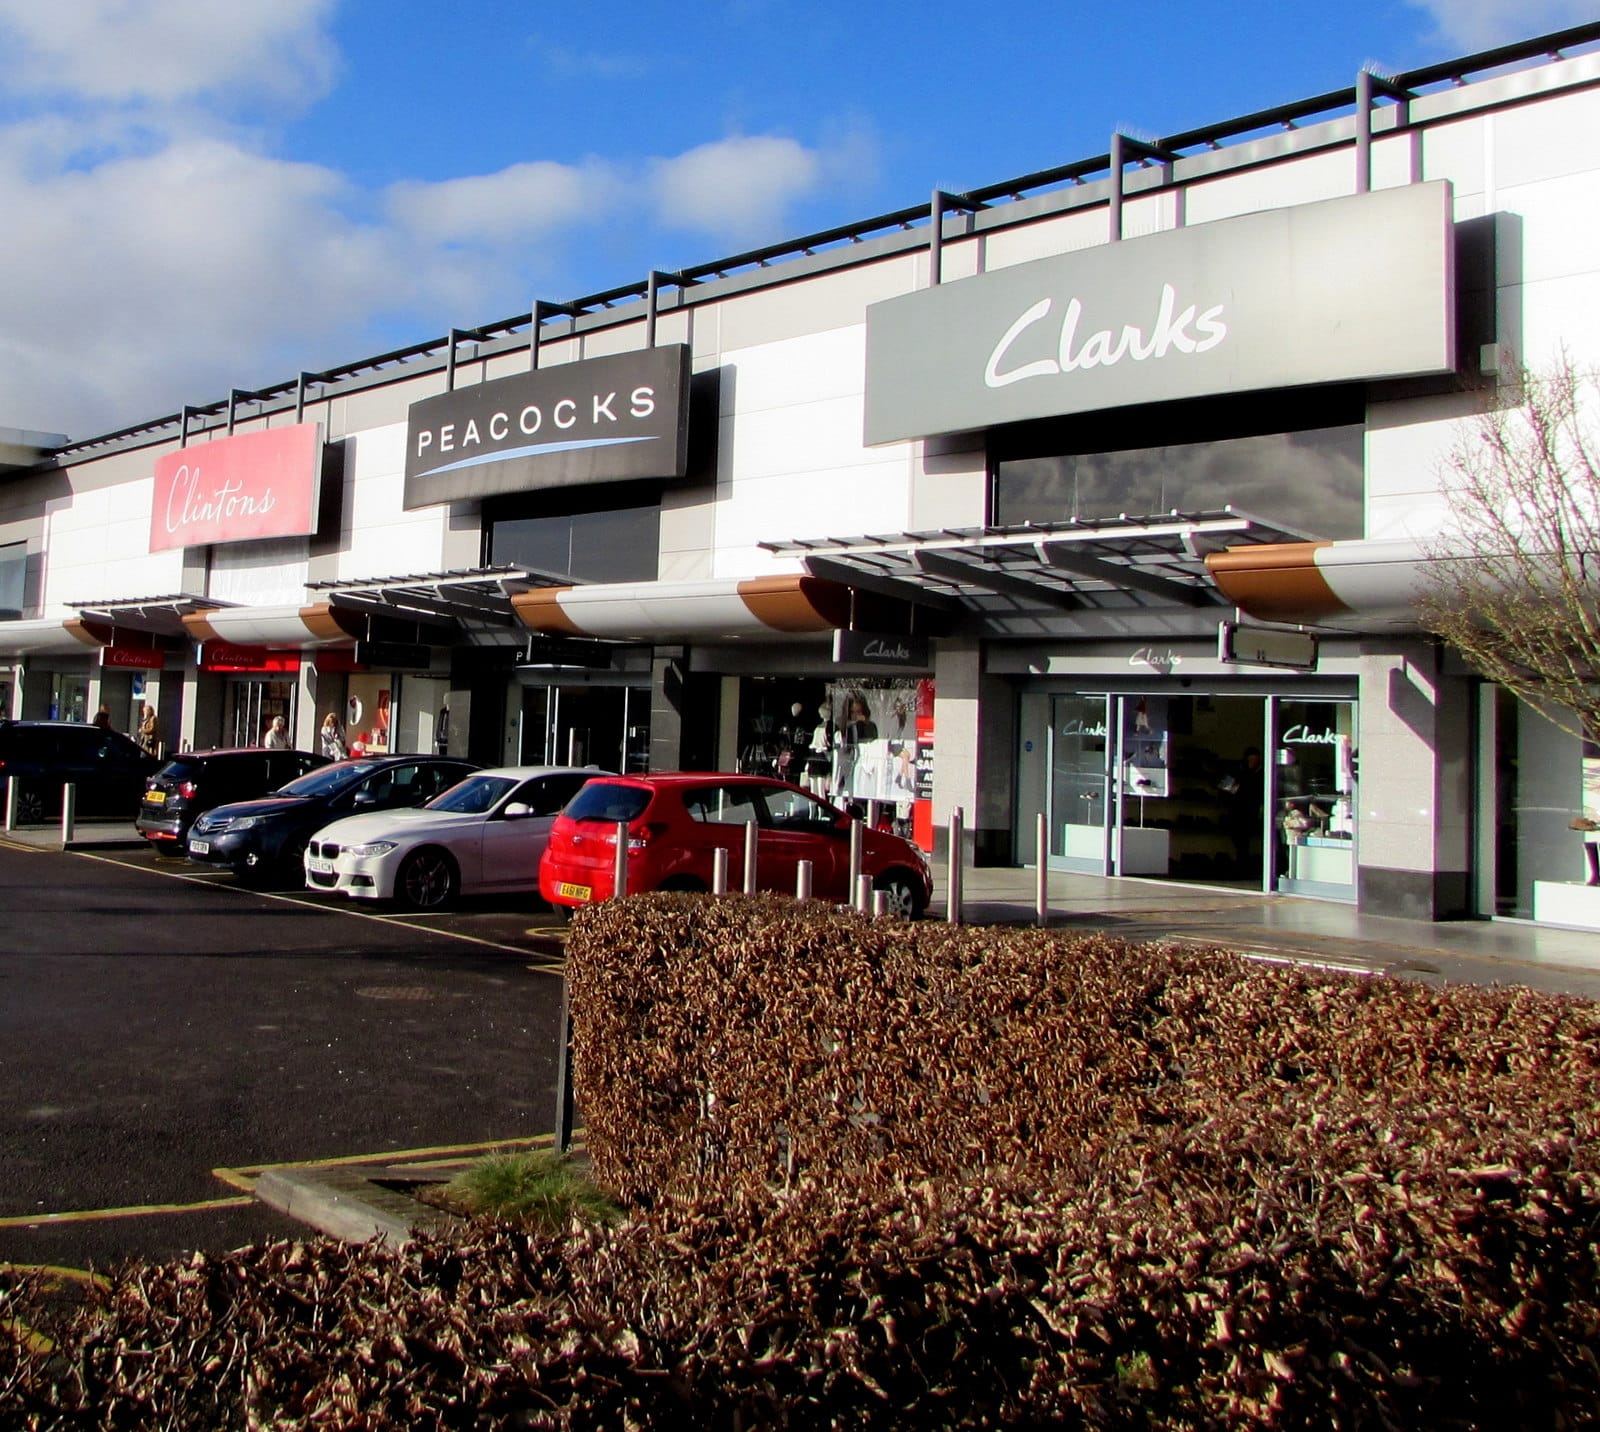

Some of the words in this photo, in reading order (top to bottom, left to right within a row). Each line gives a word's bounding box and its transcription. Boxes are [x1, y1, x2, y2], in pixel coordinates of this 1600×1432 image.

[985, 283, 1227, 388] Clarks
[417, 387, 655, 457] PEACOCKS
[166, 464, 276, 533] Clintons
[863, 639, 910, 659] Clarks
[1129, 647, 1182, 666] Clarks
